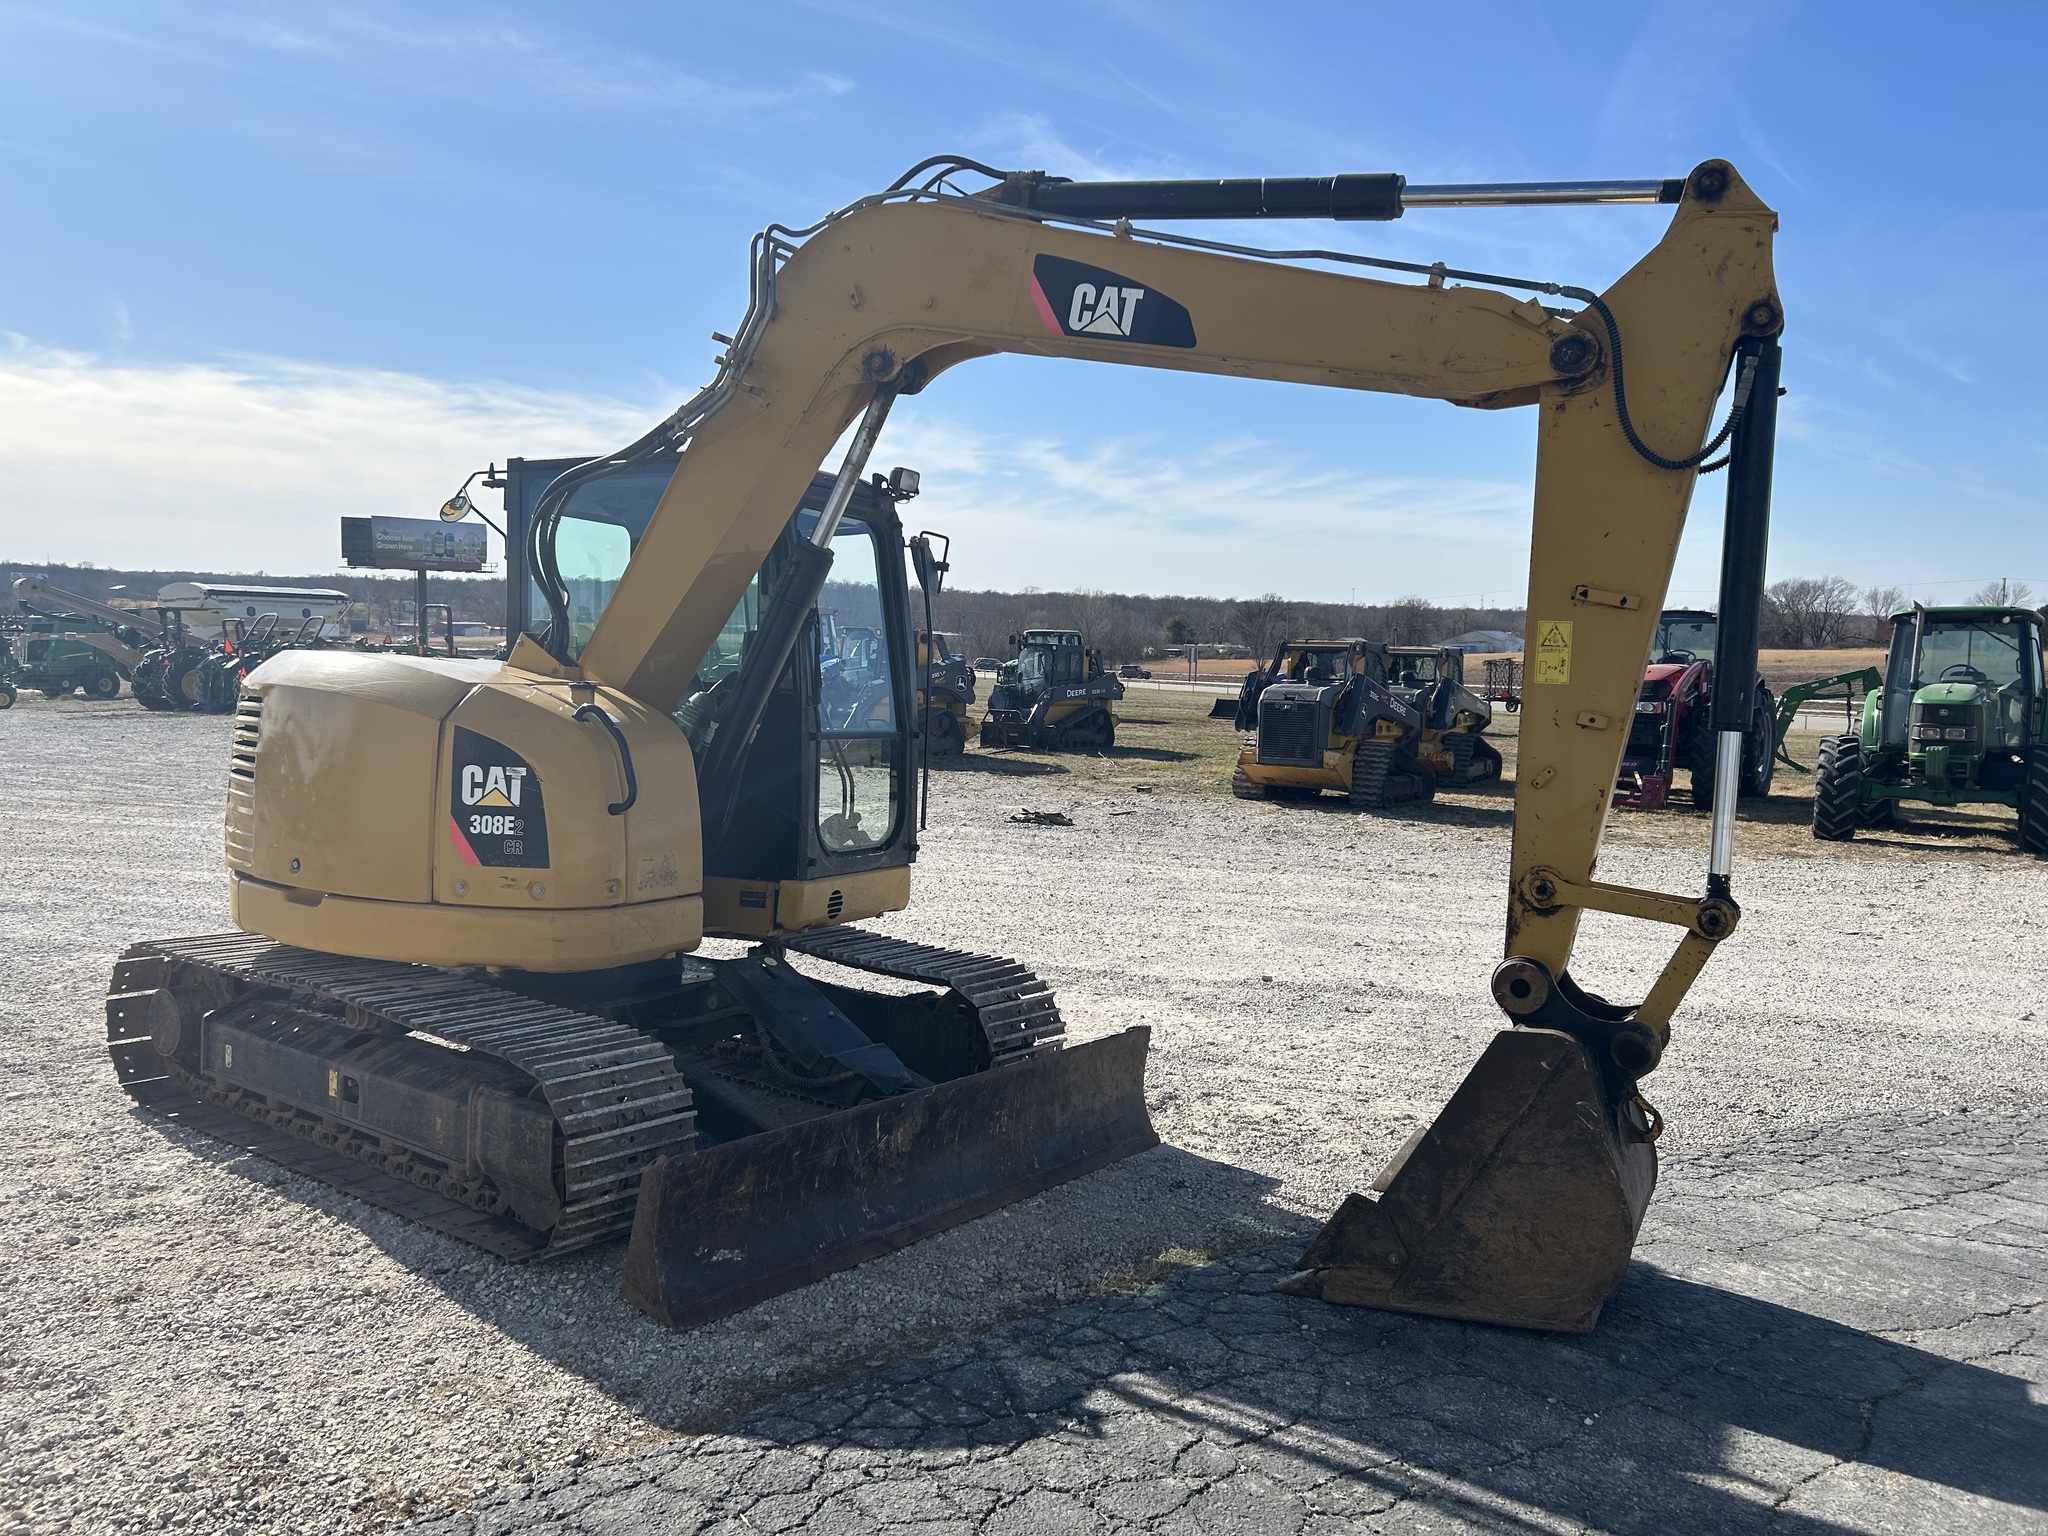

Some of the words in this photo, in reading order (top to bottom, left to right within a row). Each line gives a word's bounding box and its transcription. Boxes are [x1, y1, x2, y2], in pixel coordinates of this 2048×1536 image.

[1068, 282, 1145, 336] CAT
[376, 541, 398, 550] Grown
[398, 542, 414, 551] Here
[1066, 688, 1087, 698] DEERE
[1390, 697, 1407, 717] DEERE
[461, 764, 527, 808] CAT
[469, 814, 525, 836] 308E2
[503, 839, 524, 855] CR
